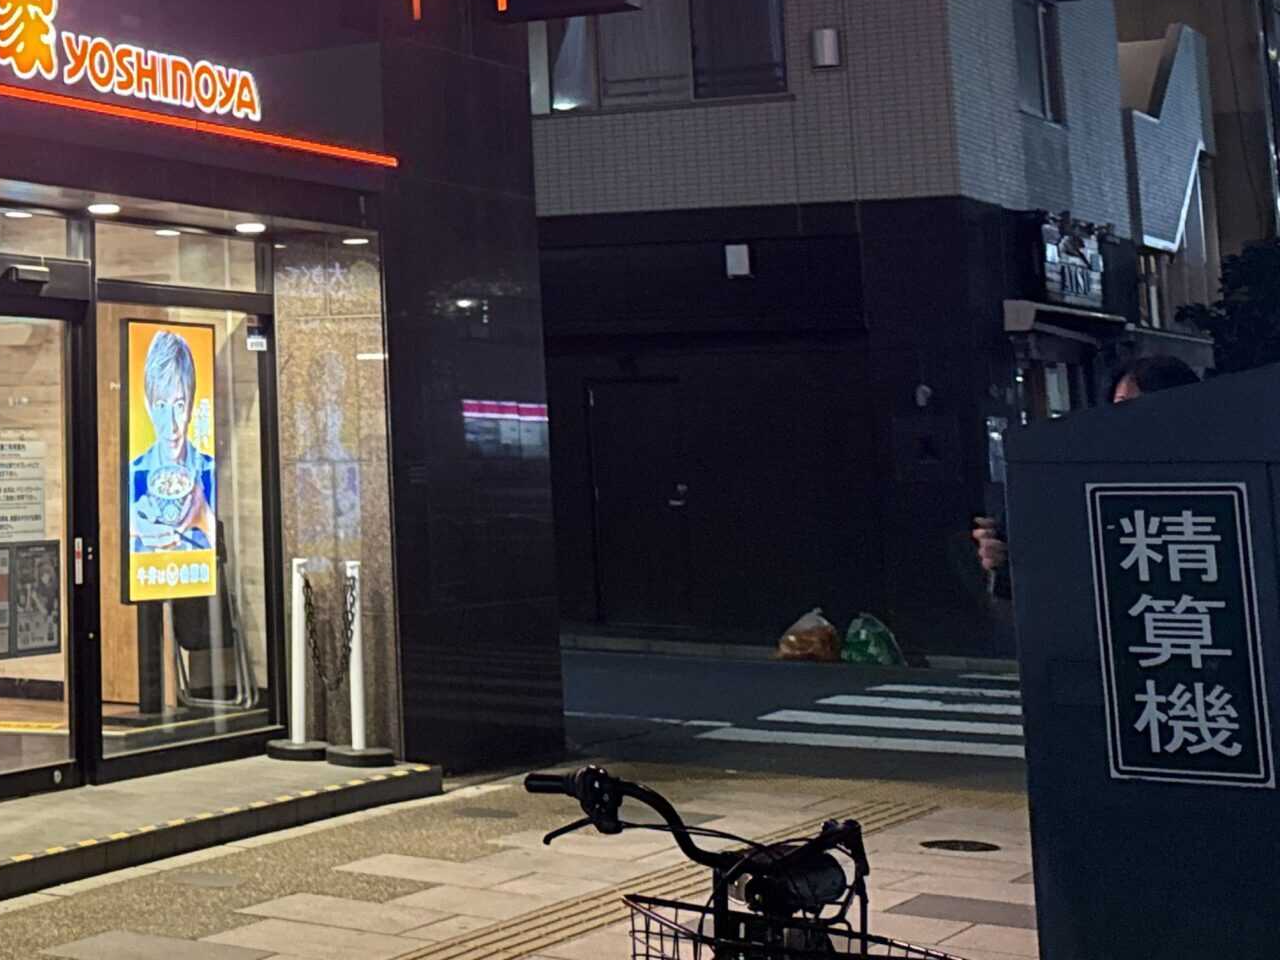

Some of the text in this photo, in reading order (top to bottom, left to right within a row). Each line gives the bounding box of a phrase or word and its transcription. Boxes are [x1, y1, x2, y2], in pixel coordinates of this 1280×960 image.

[62, 30, 263, 123] YOSHINOYA
[1118, 510, 1243, 757] 精算機
